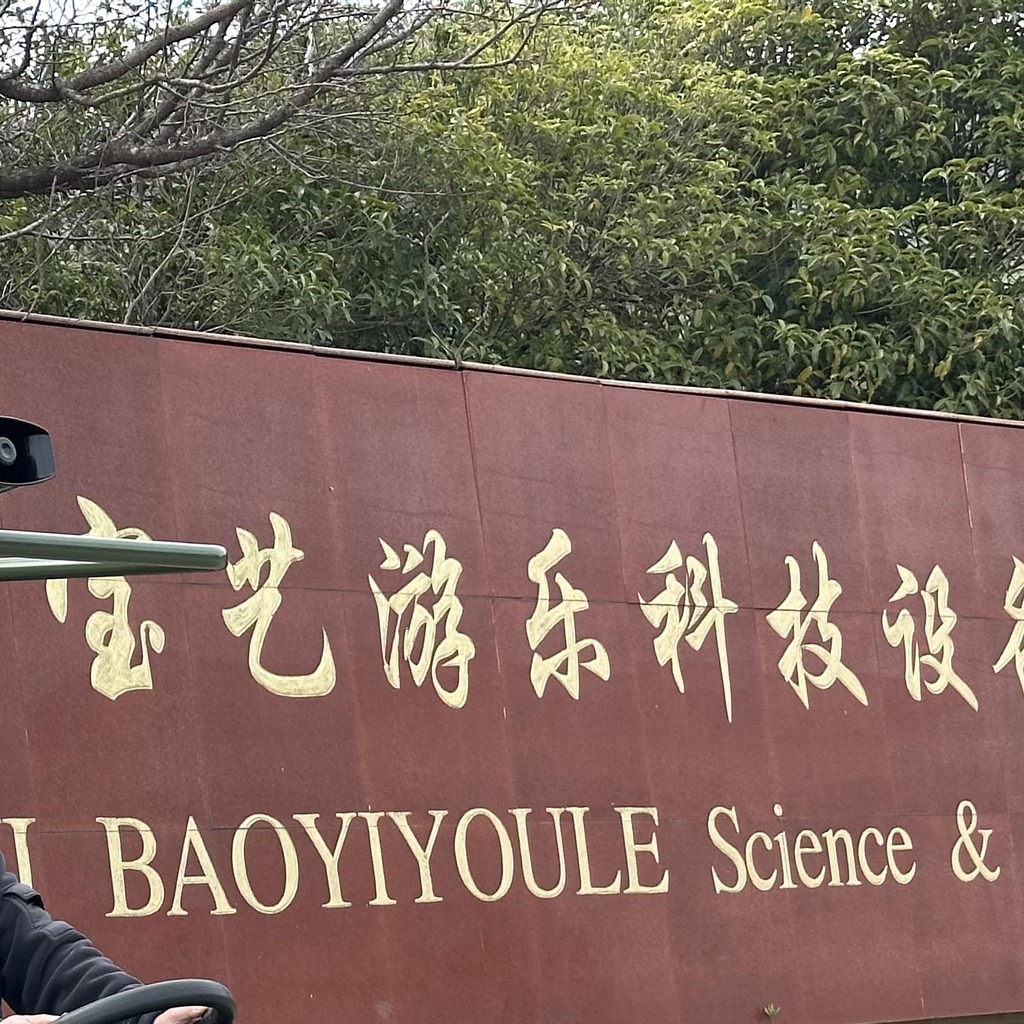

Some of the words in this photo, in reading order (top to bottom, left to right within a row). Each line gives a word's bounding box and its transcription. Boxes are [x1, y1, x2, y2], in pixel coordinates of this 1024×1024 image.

[95, 805, 670, 918] BAOYIYOULE
[707, 803, 916, 894] Science
[950, 800, 1000, 883] &
